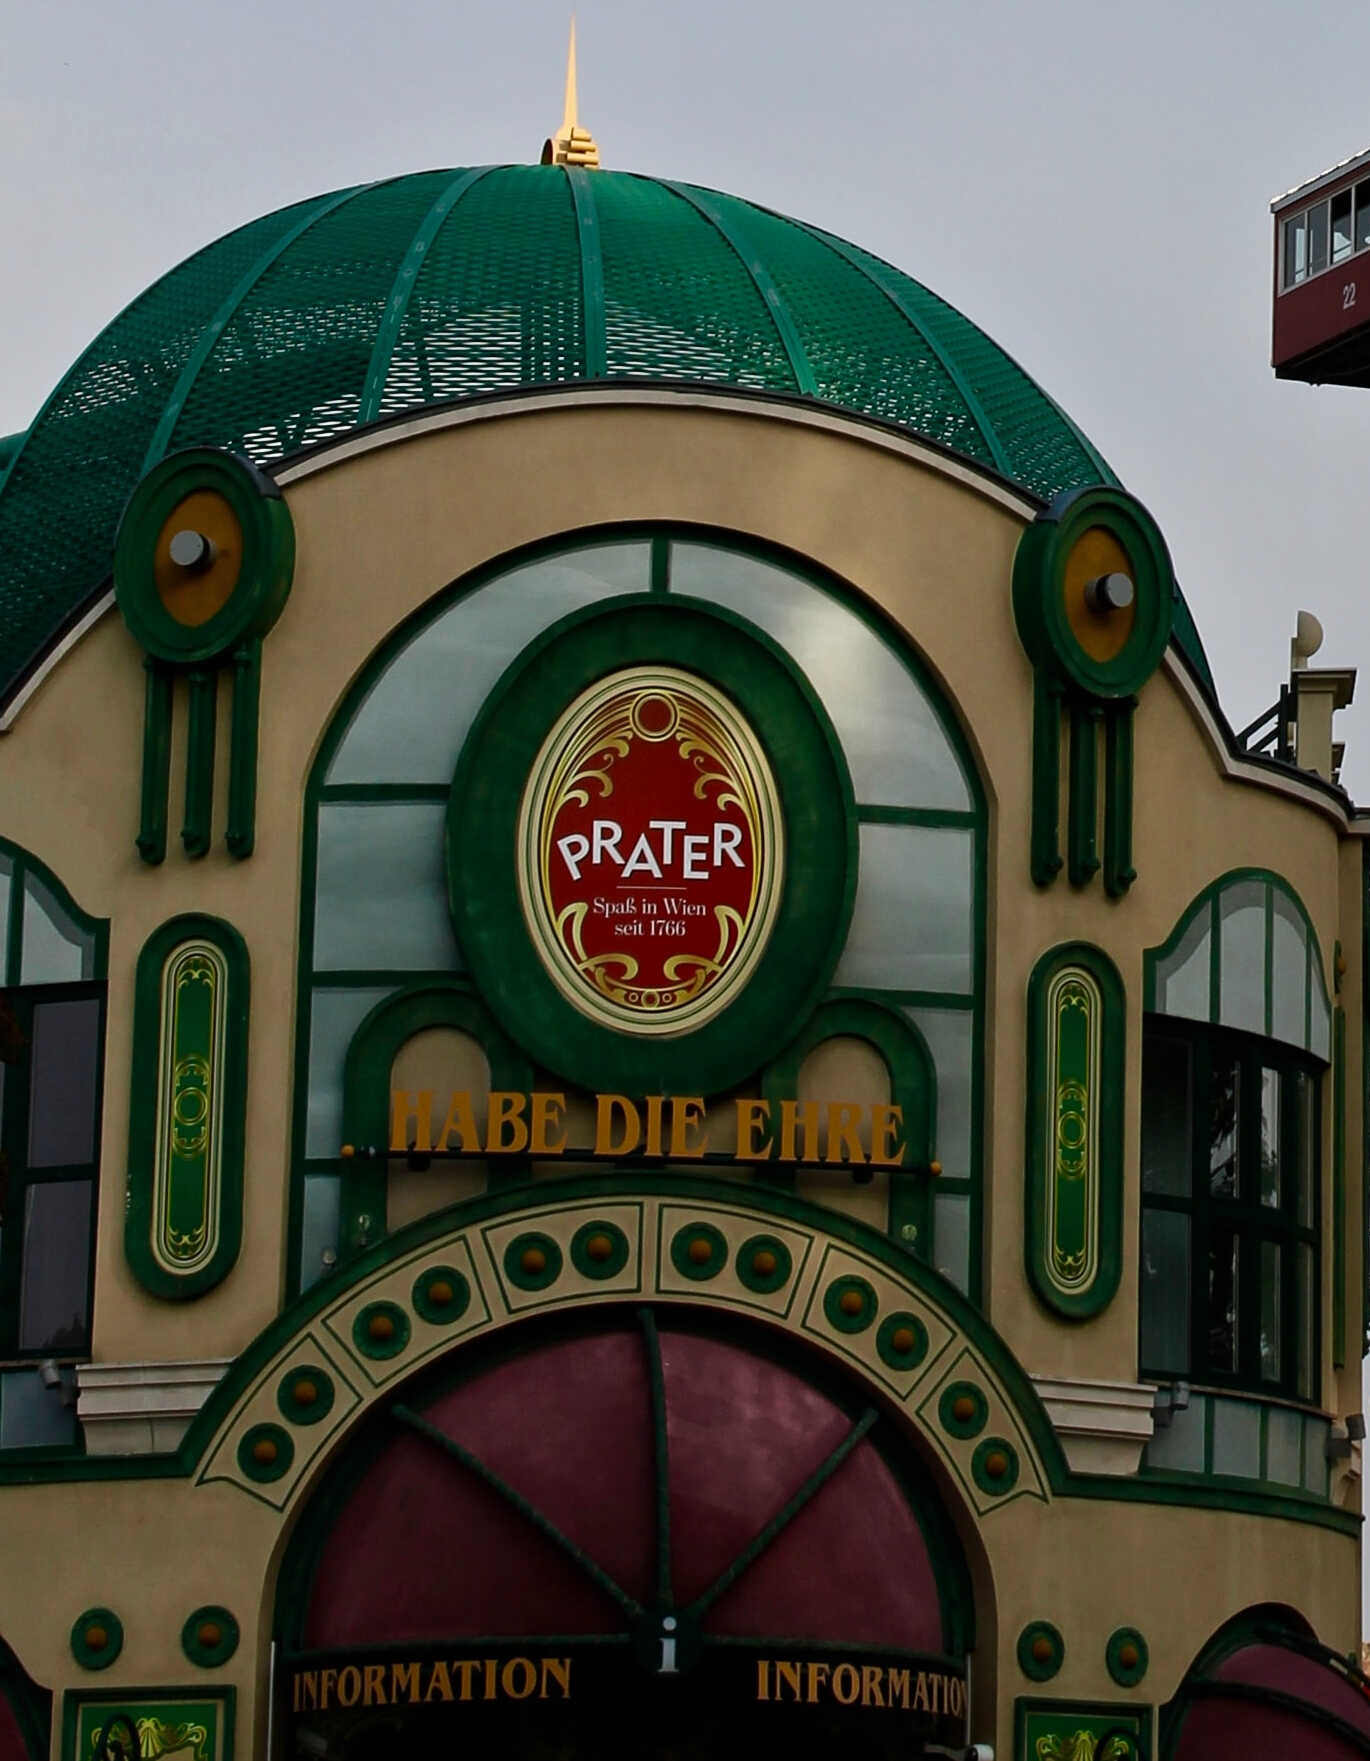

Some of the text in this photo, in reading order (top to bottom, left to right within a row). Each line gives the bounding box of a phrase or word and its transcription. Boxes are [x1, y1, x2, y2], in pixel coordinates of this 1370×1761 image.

[1342, 282, 1357, 310] 22
[556, 820, 746, 881] PRATER
[593, 897, 707, 918] Spaß in Wien
[614, 919, 687, 937] seit 1766
[389, 1088, 907, 1166] HABE DIE EHRE
[658, 1616, 679, 1673] i
[293, 1657, 573, 1713] INFORMATION
